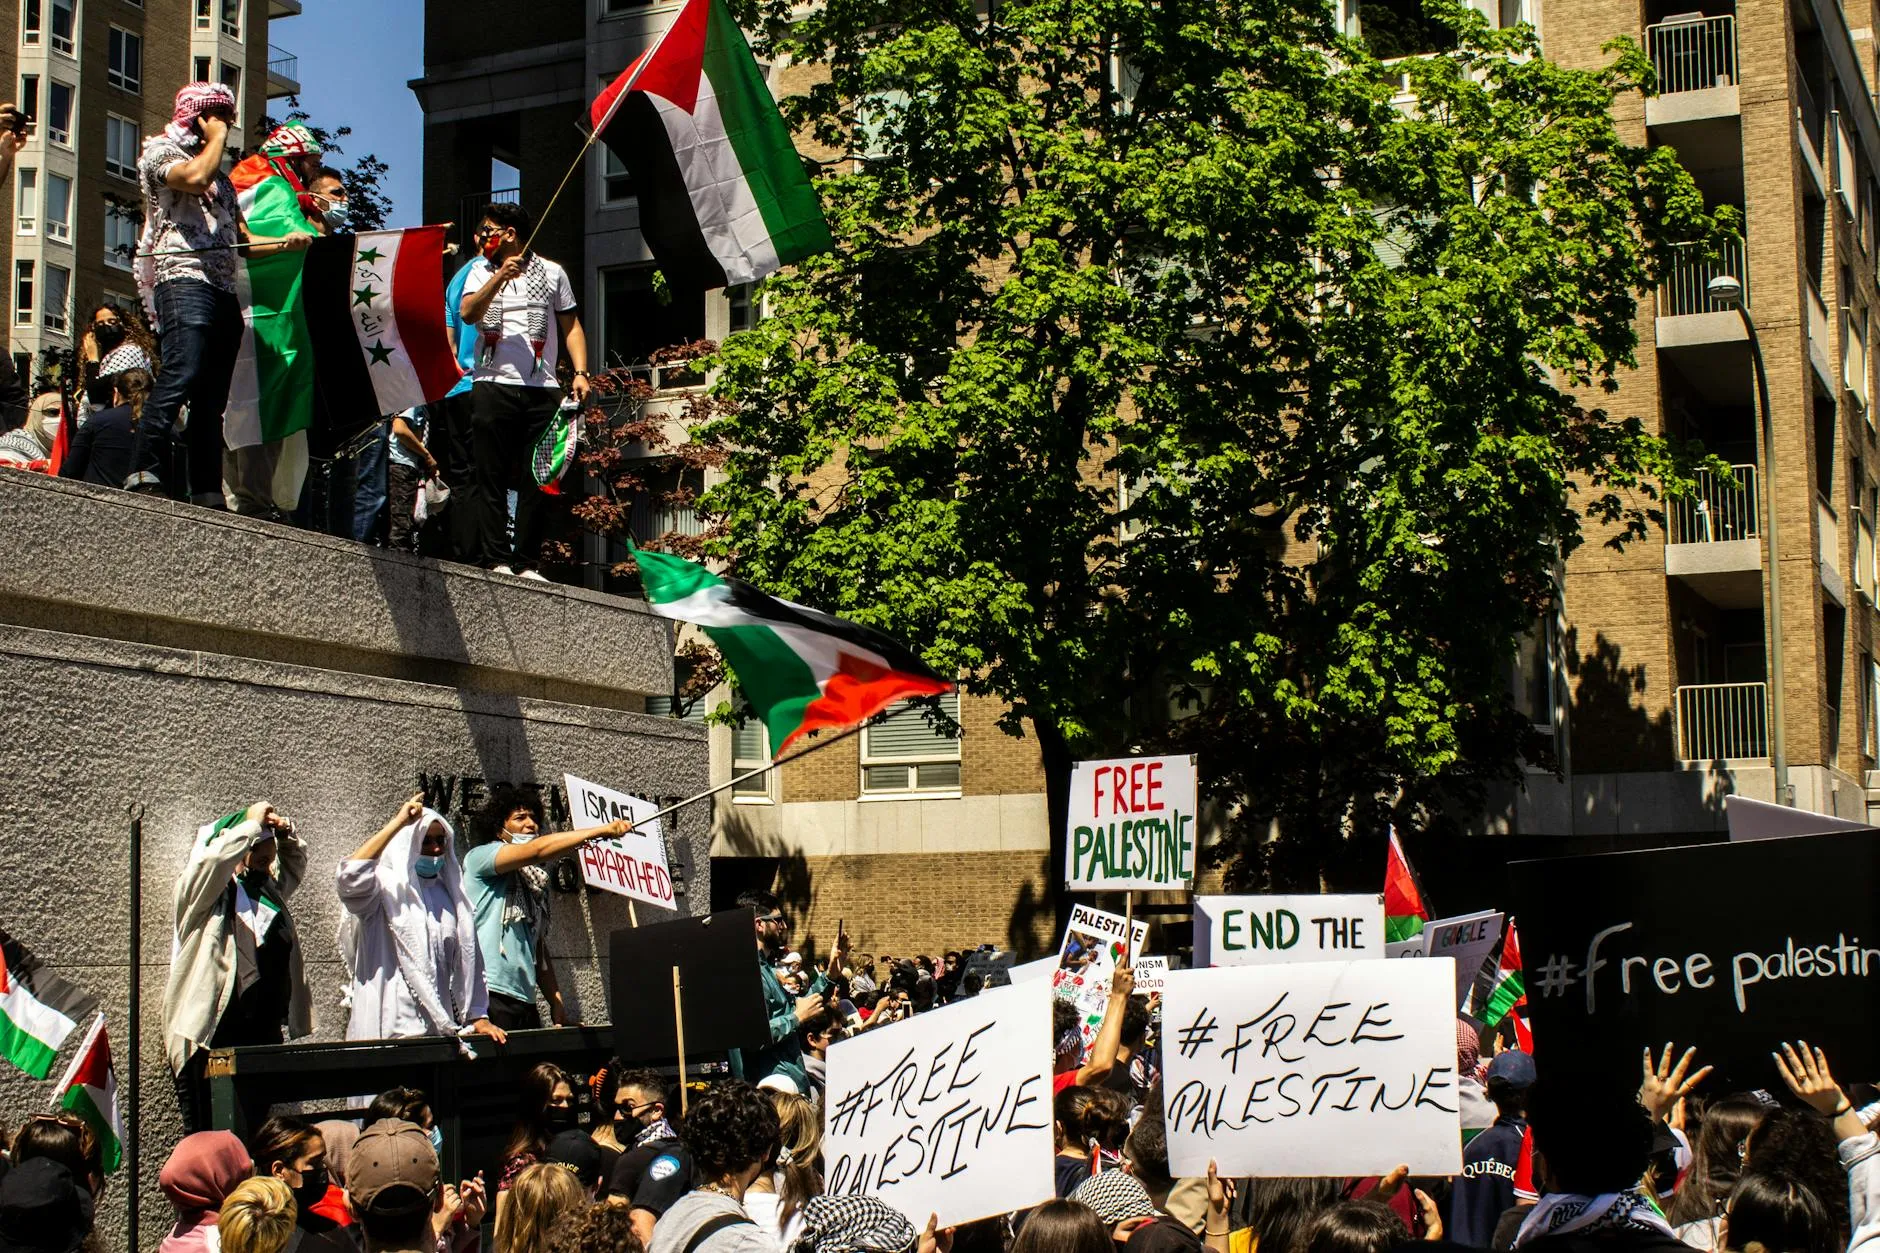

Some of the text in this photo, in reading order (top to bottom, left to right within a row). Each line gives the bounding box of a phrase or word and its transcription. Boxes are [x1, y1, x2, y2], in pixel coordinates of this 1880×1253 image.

[582, 788, 646, 837] ISRAEL
[1094, 762, 1164, 818] FREE
[584, 840, 672, 901] APARTHEID
[1073, 809, 1193, 884] PALESTINE
[1223, 909, 1365, 951] END THE
[1138, 970, 1150, 978] IS
[1533, 921, 1716, 1014] #free
[1178, 991, 1405, 1074] #FREE
[830, 1020, 997, 1137] #FREE
[1167, 1066, 1458, 1140] PALESTINE
[827, 1073, 1050, 1197] PALESTINE
